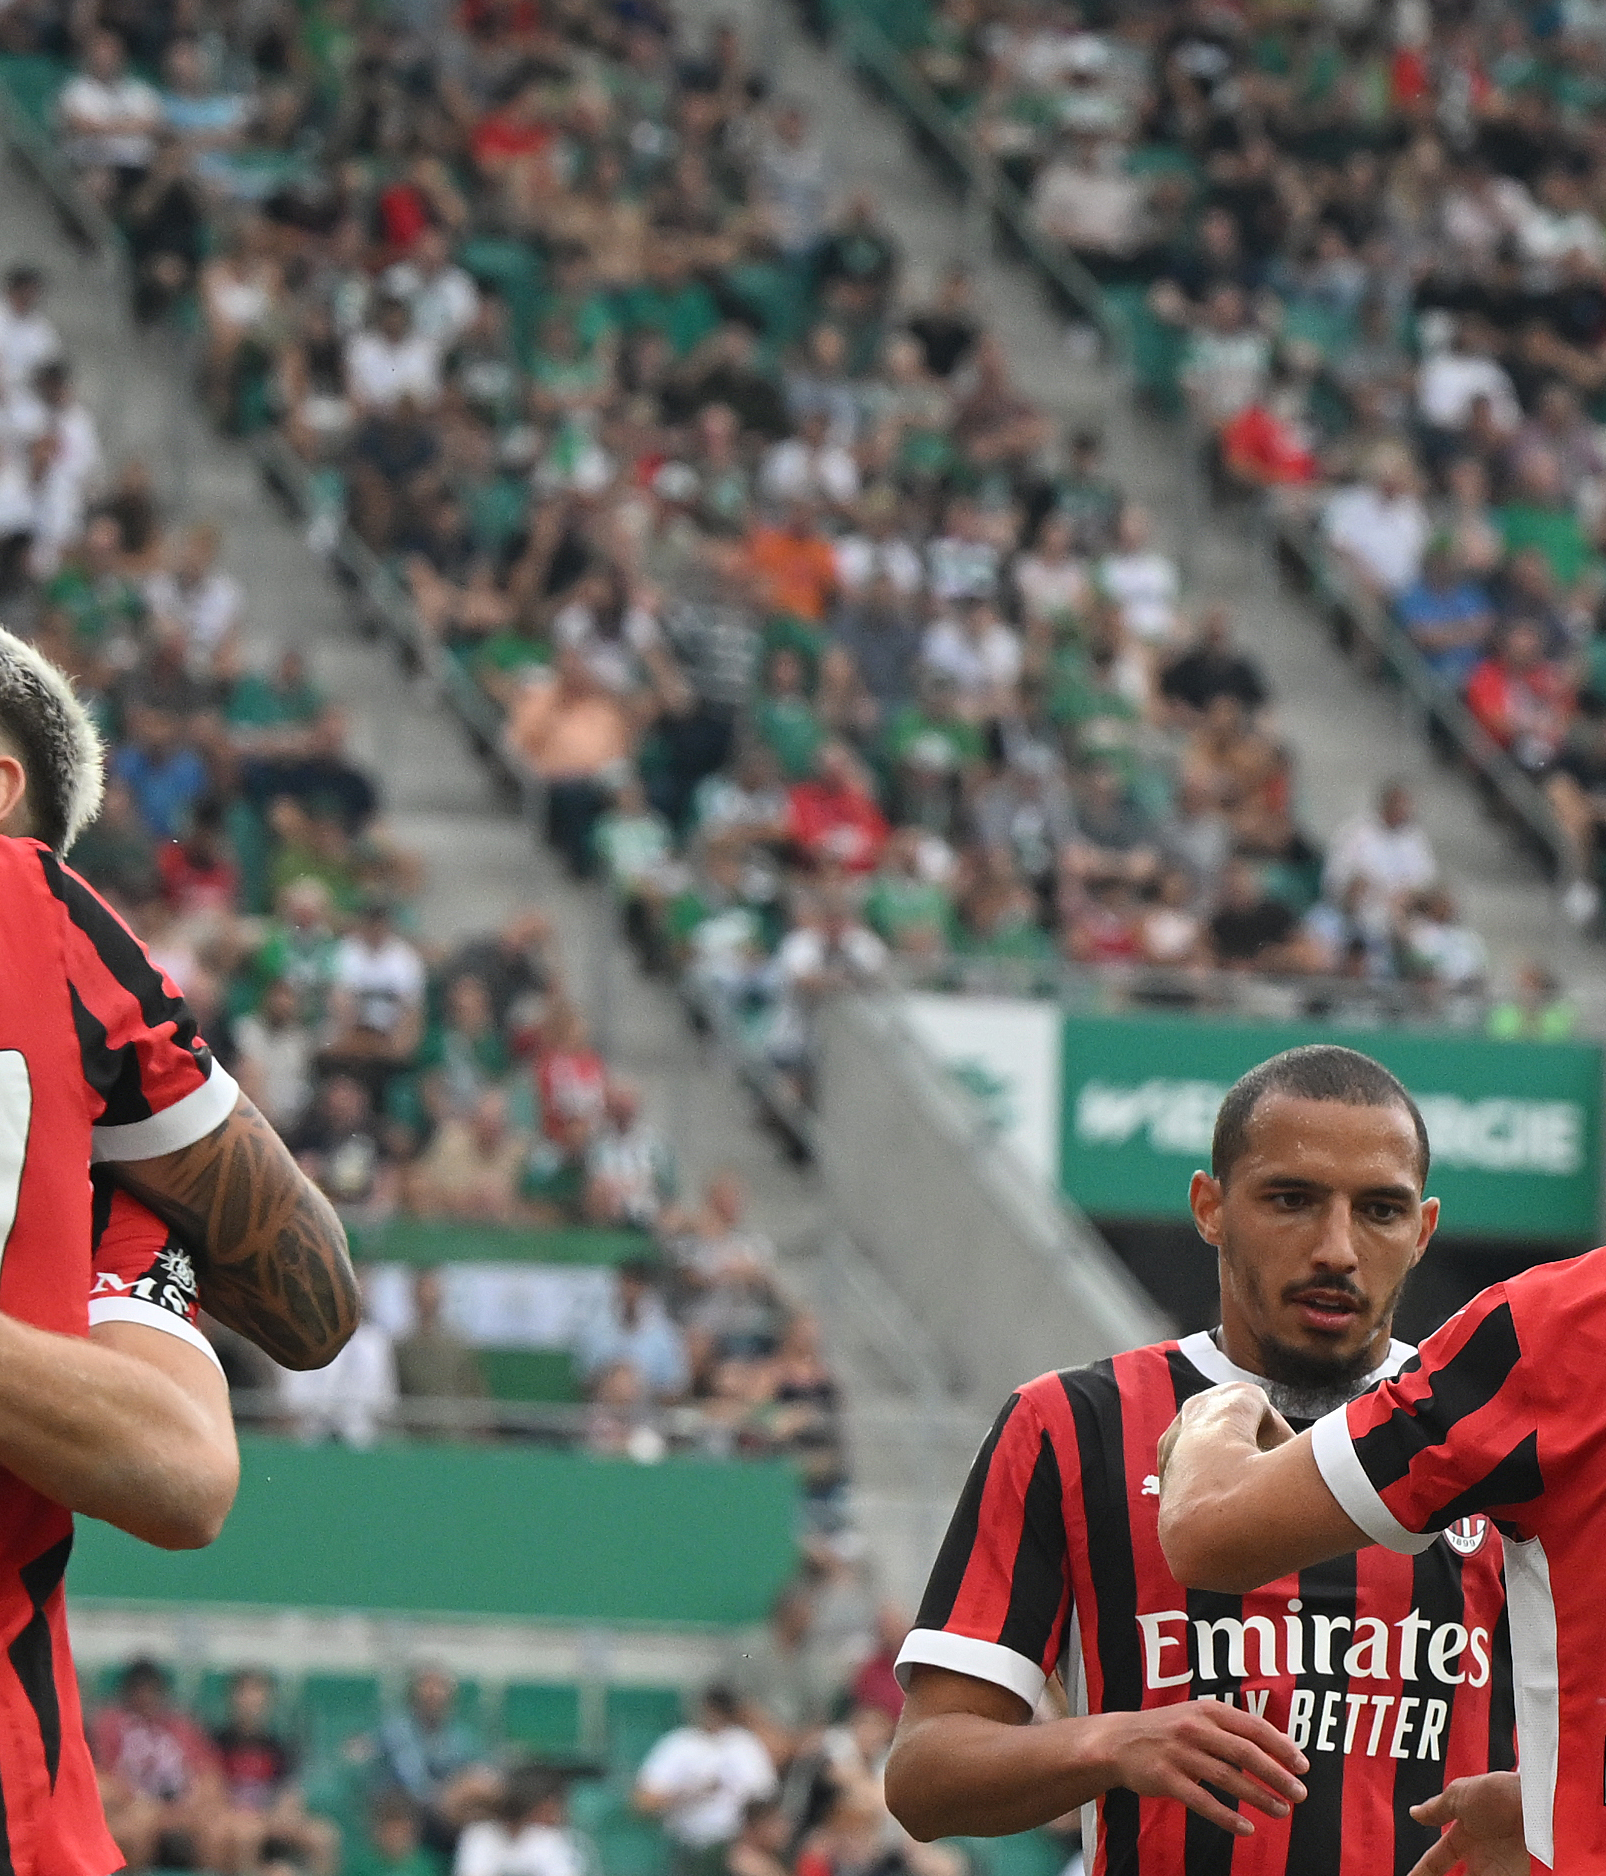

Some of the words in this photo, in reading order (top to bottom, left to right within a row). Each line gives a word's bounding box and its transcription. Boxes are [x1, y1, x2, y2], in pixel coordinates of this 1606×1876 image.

[89, 1271, 193, 1324] MS
[1452, 1536, 1486, 1548] 1899
[1135, 1598, 1493, 1690] Emirates
[1287, 1689, 1449, 1762] BETTER
